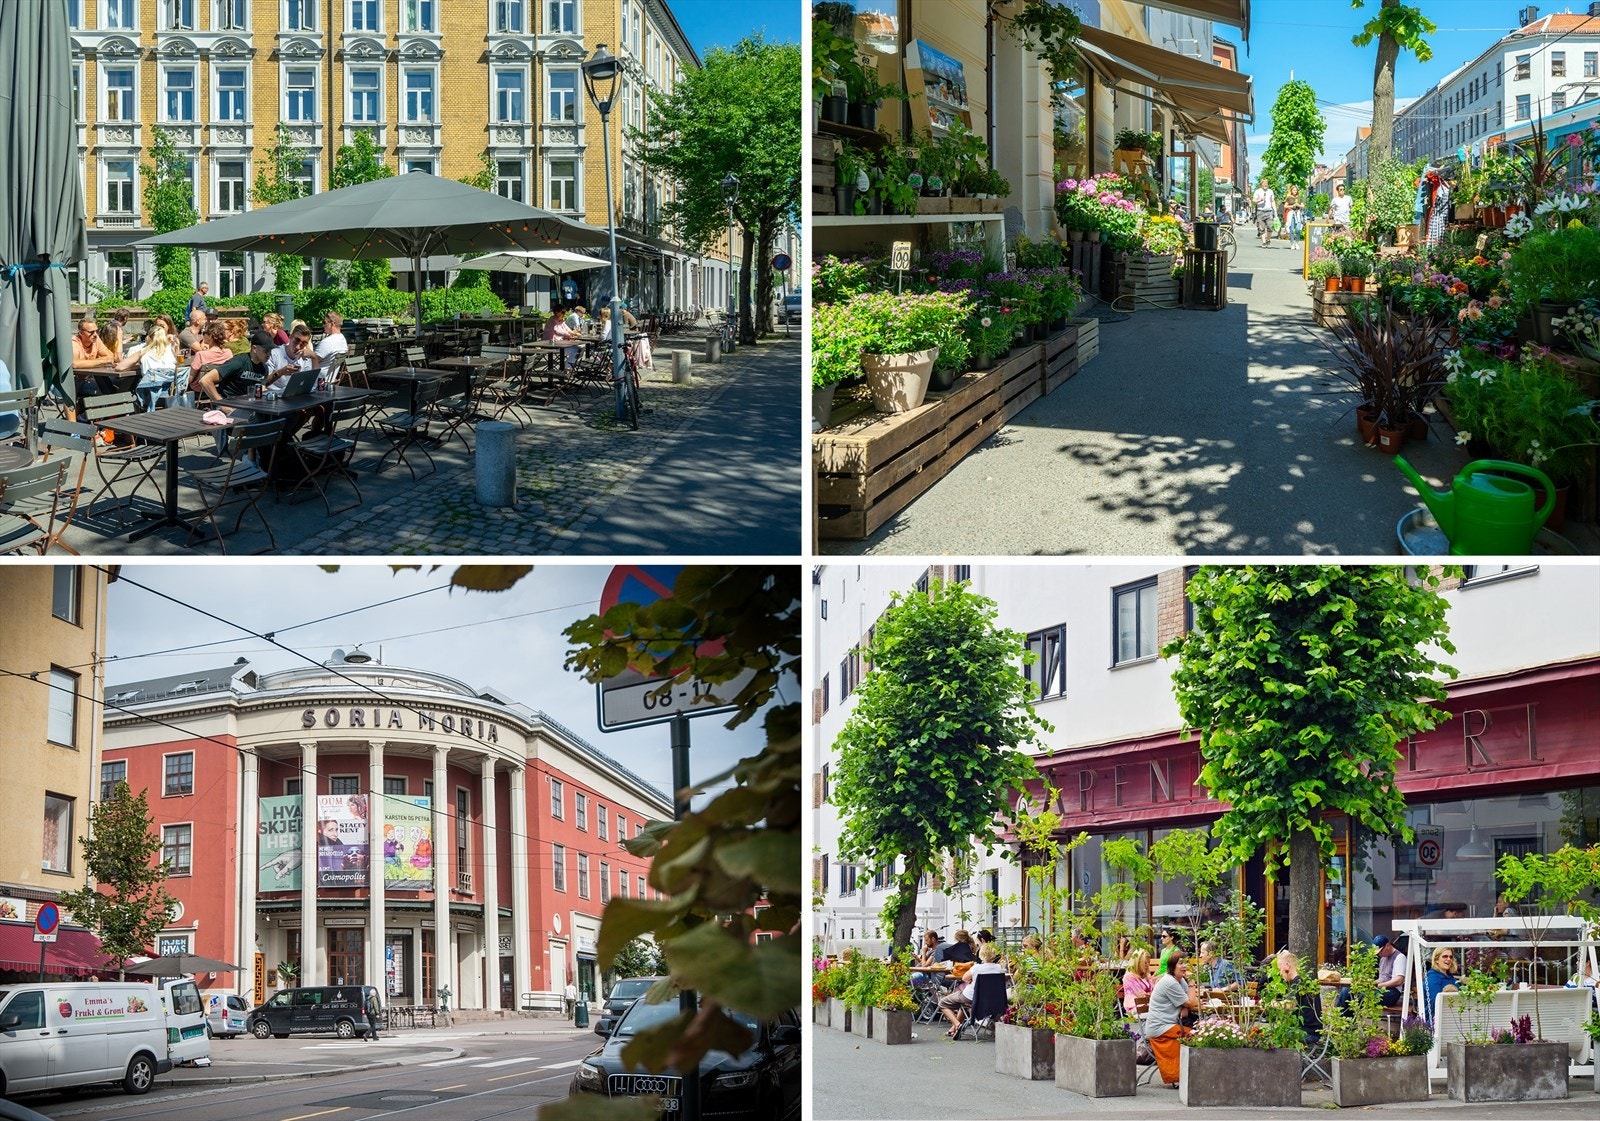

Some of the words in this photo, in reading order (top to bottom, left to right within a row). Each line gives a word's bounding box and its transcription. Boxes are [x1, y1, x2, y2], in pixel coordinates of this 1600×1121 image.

[302, 707, 403, 728] SORIA
[419, 711, 498, 743] MORIA
[321, 797, 343, 805] OUM
[273, 804, 303, 819] HVA
[322, 872, 366, 882] Cosmopolite
[85, 997, 113, 1005] Emma's
[75, 1008, 95, 1017] Frukt
[97, 1008, 103, 1016] &
